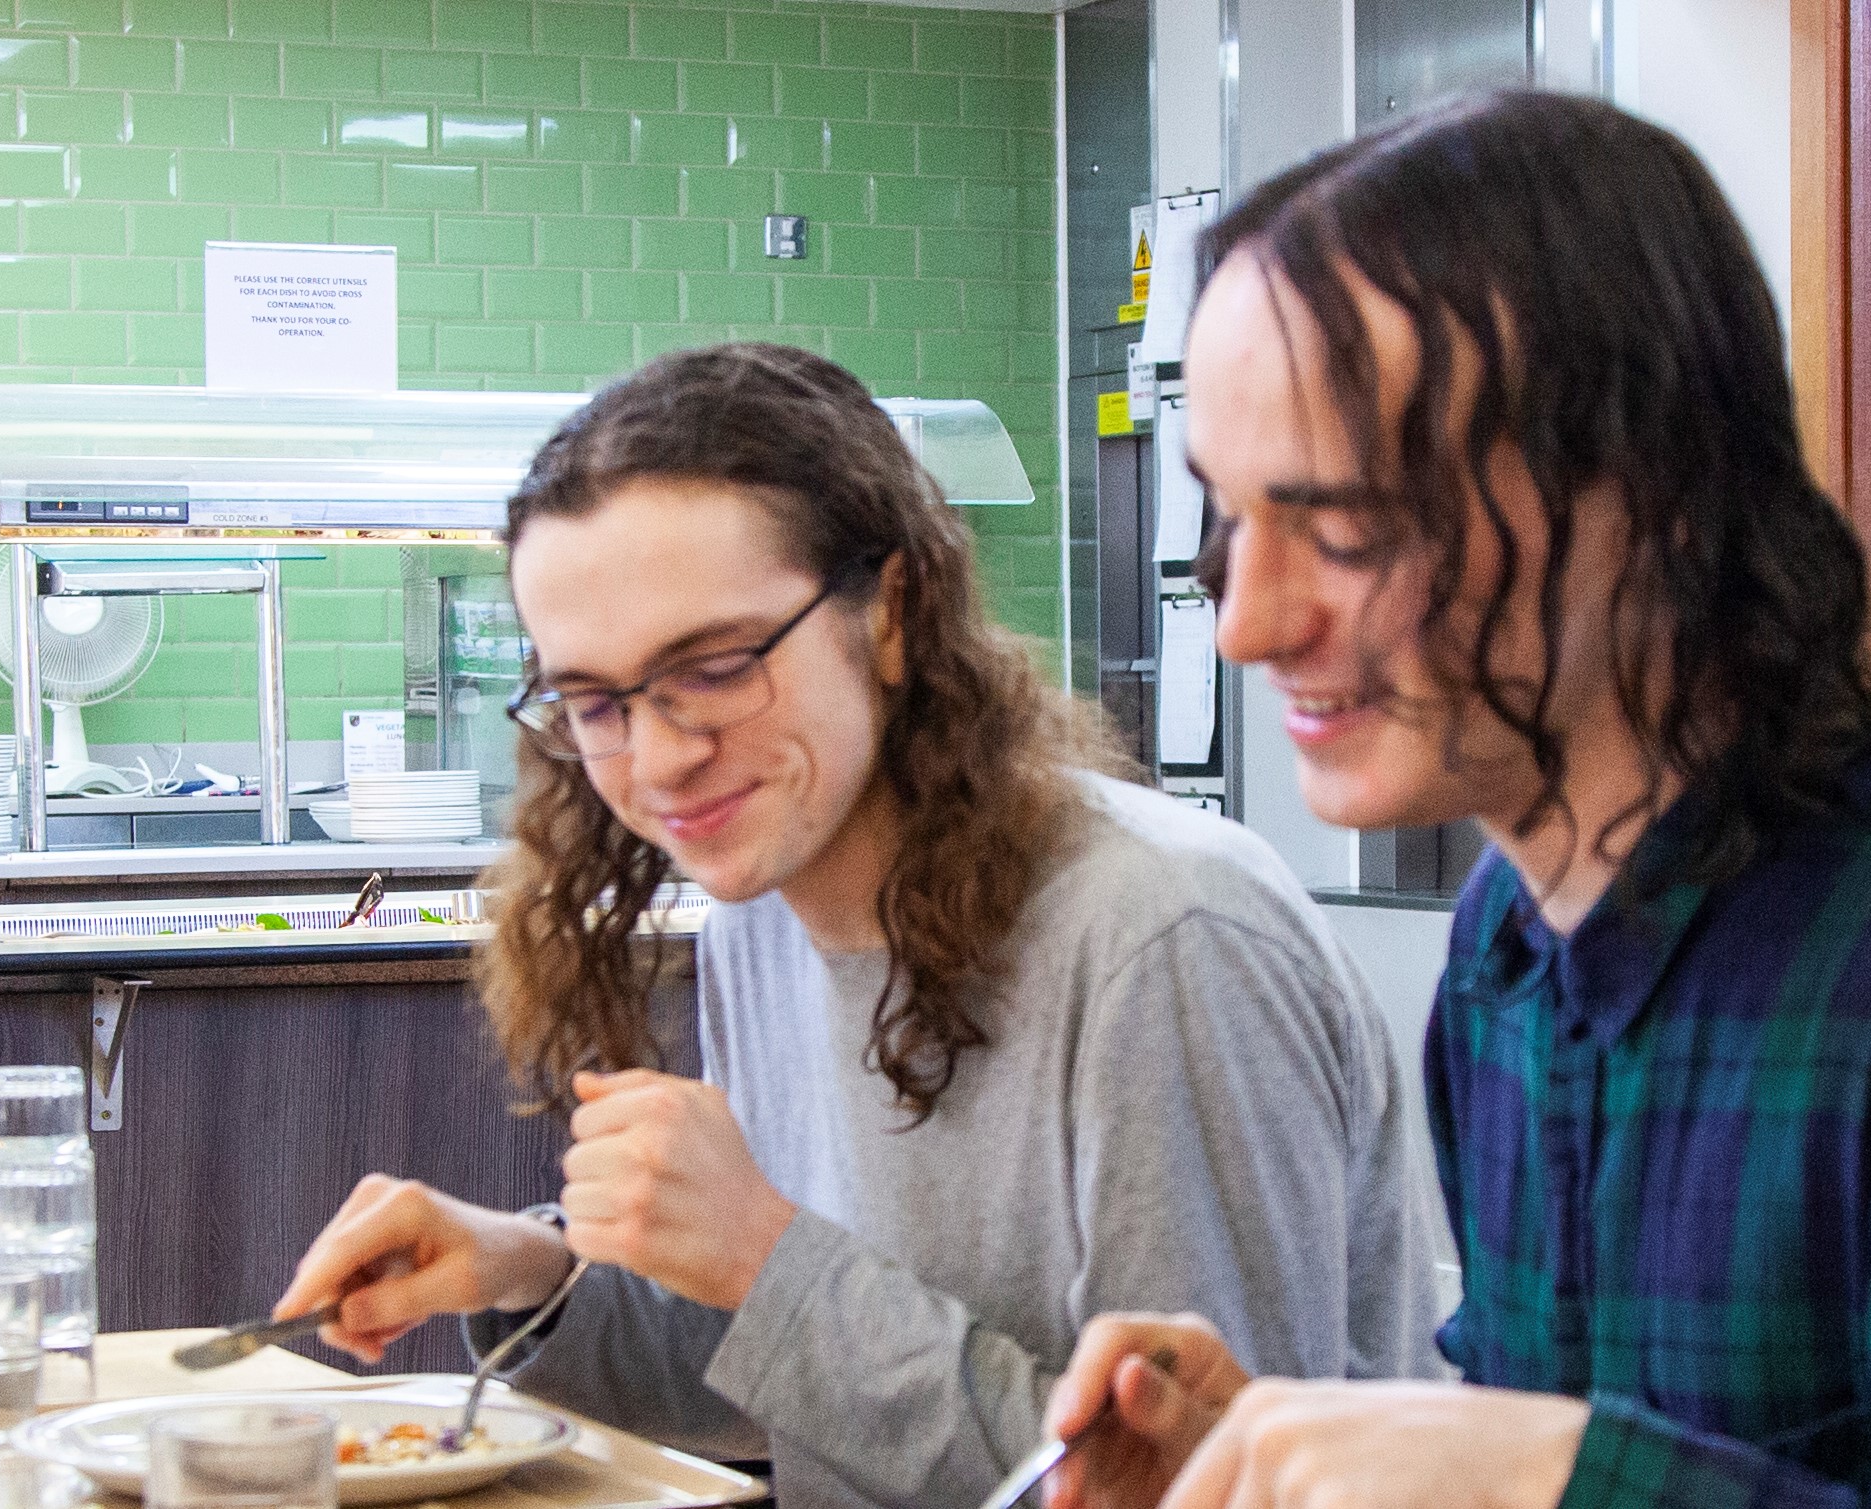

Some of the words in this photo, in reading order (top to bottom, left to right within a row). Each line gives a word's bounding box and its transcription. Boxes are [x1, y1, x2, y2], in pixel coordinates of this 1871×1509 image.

[234, 275, 261, 283] PLEASE
[280, 276, 294, 284] THE
[296, 277, 330, 285] CORRECT
[332, 278, 367, 286] UTENSILS
[257, 288, 278, 296] EACH
[338, 290, 363, 298] CROSS
[267, 301, 336, 310] CONTAMINATION.
[279, 316, 296, 324] YOU
[315, 317, 336, 325] YOUR
[278, 329, 325, 337] OPERATION.
[213, 514, 235, 522] COLD
